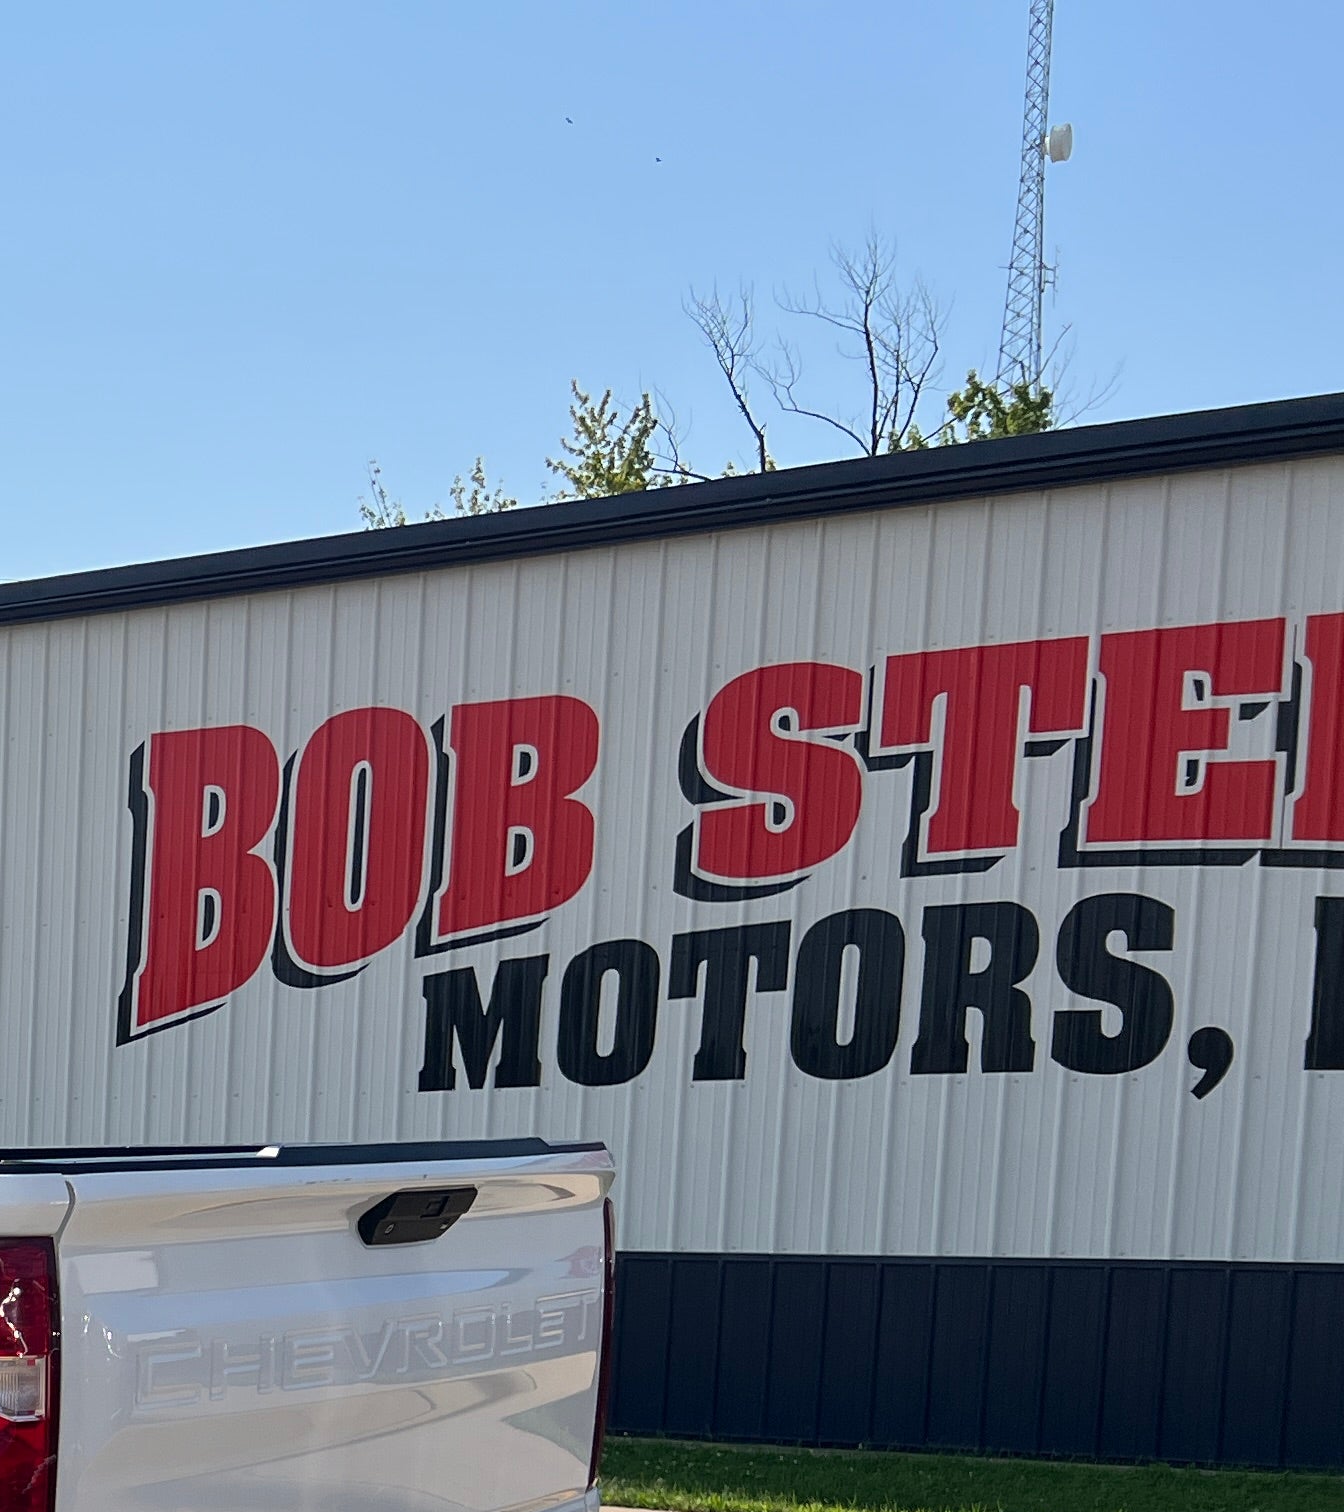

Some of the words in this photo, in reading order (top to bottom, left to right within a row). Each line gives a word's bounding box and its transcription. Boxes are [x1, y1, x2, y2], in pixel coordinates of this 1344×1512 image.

[116, 694, 599, 1048] BOB
[418, 892, 1234, 1100] MOTORS,
[135, 1287, 599, 1411] CHEVROLET
